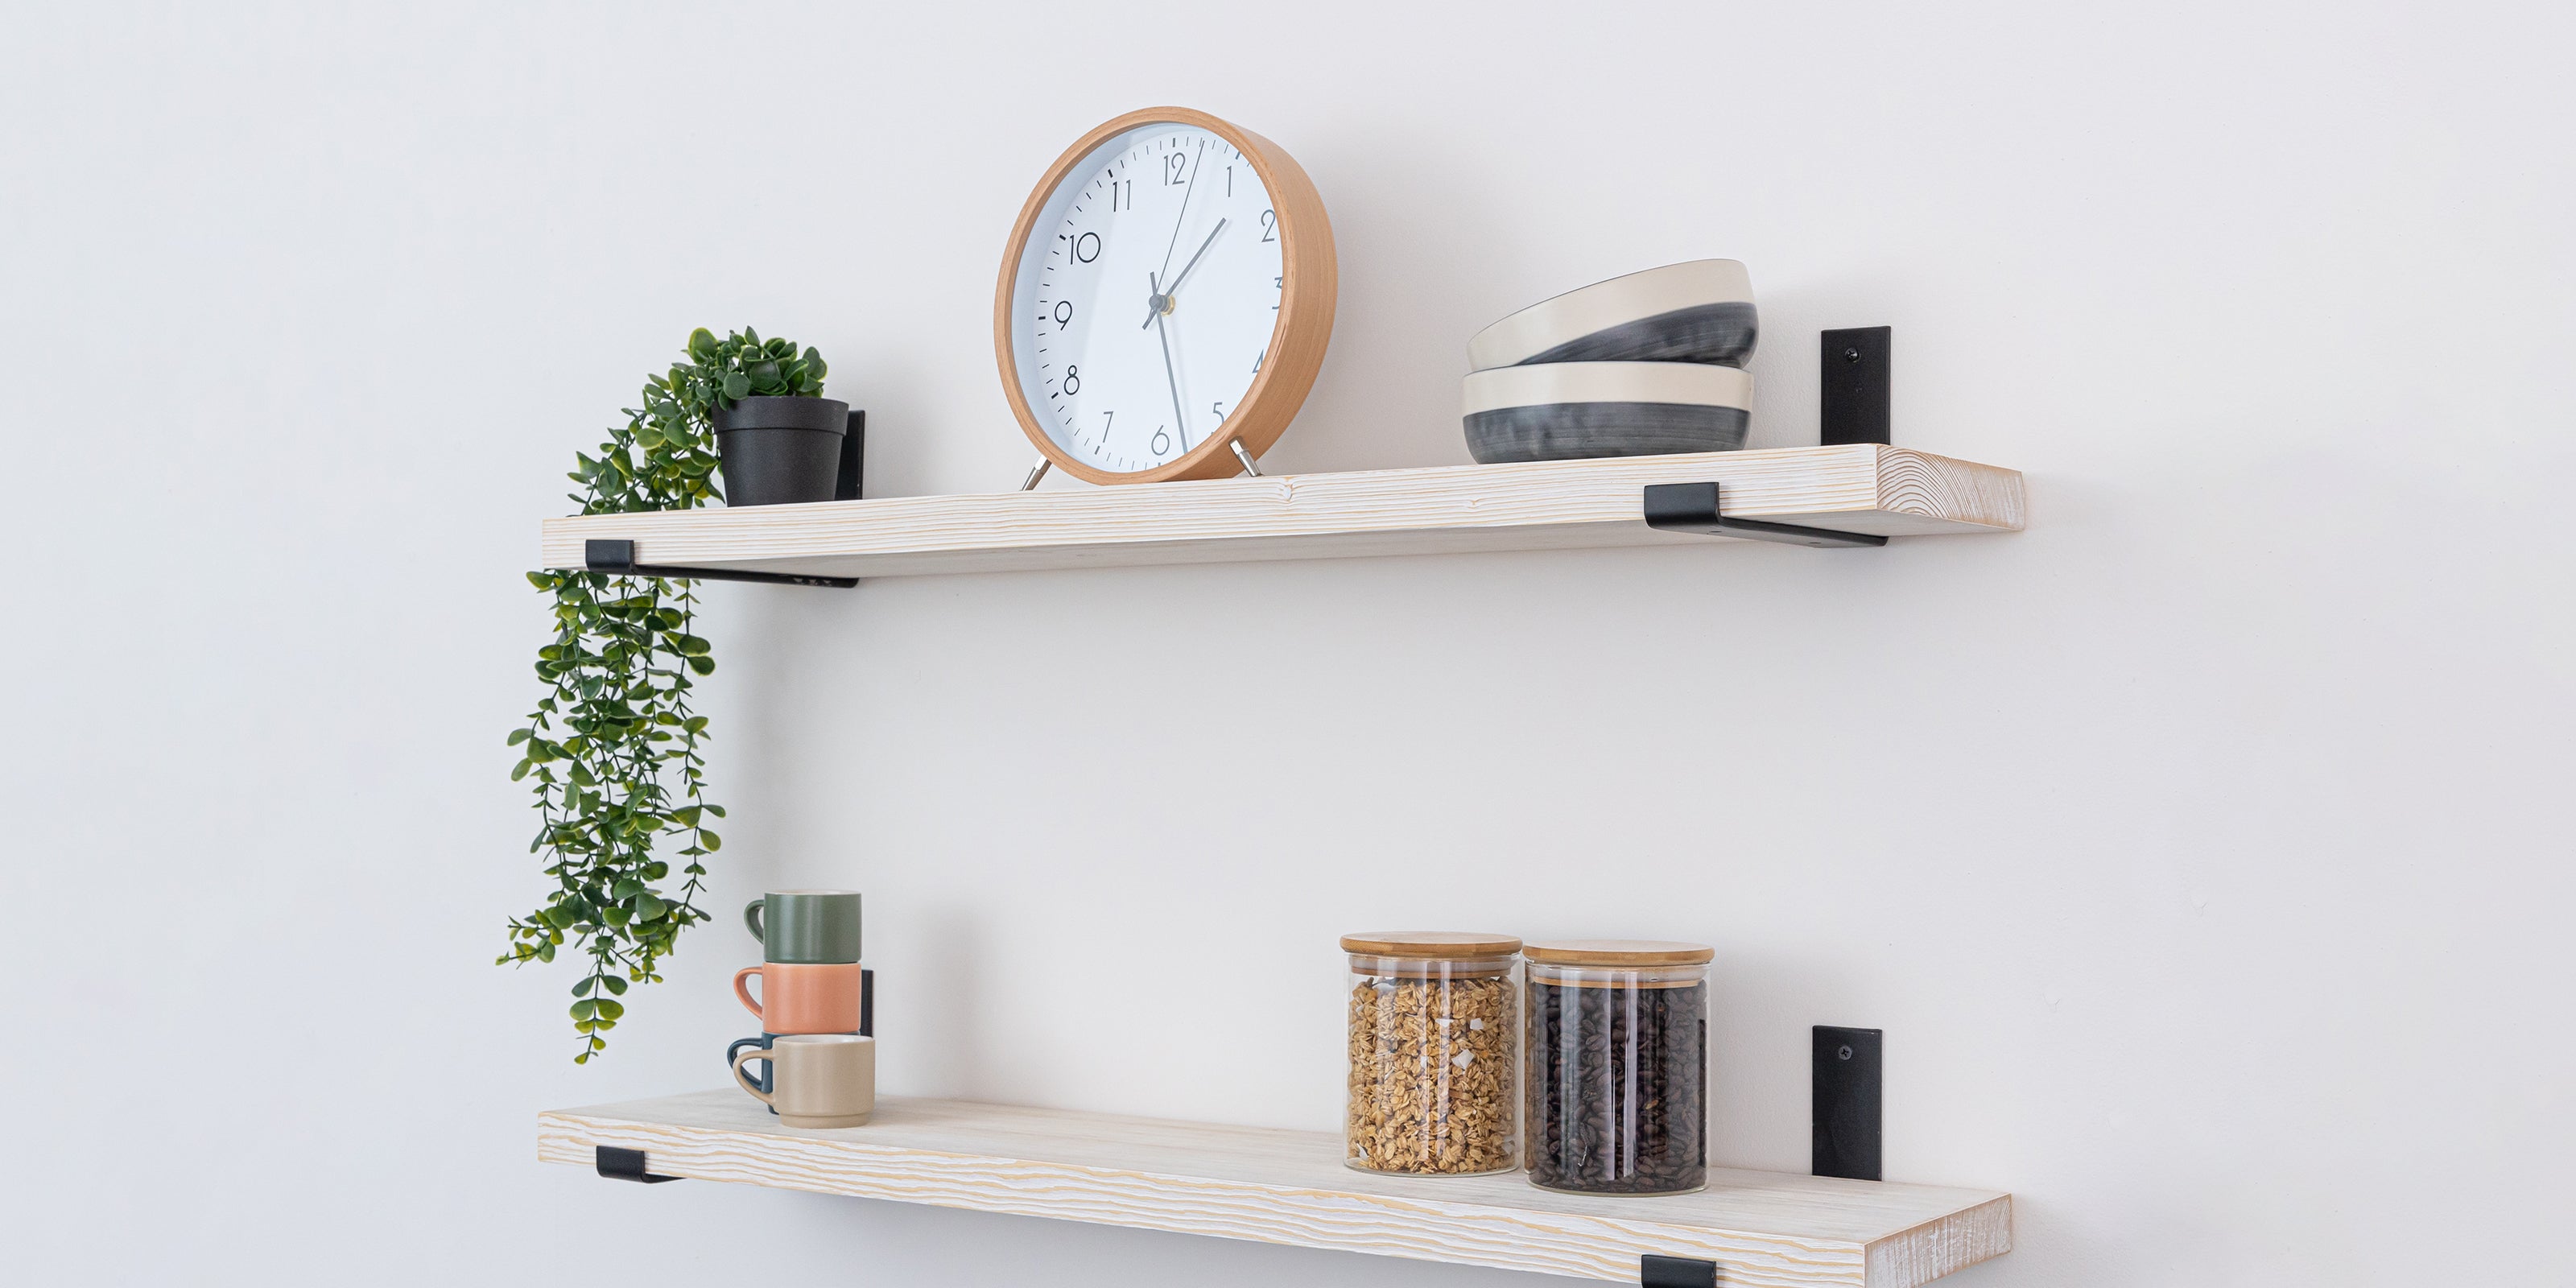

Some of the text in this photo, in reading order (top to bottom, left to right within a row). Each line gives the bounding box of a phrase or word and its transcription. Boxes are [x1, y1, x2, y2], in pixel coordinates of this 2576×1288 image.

[1164, 152, 1185, 186] 12
[1226, 165, 1232, 198] 1
[1113, 179, 1131, 213] 11
[1261, 208, 1277, 243] 2
[1069, 231, 1101, 266] 10
[1055, 300, 1073, 331] 9
[1063, 365, 1080, 396] 8
[1103, 410, 1114, 444] 7
[1211, 401, 1225, 436] 5
[1151, 424, 1170, 456] 6
